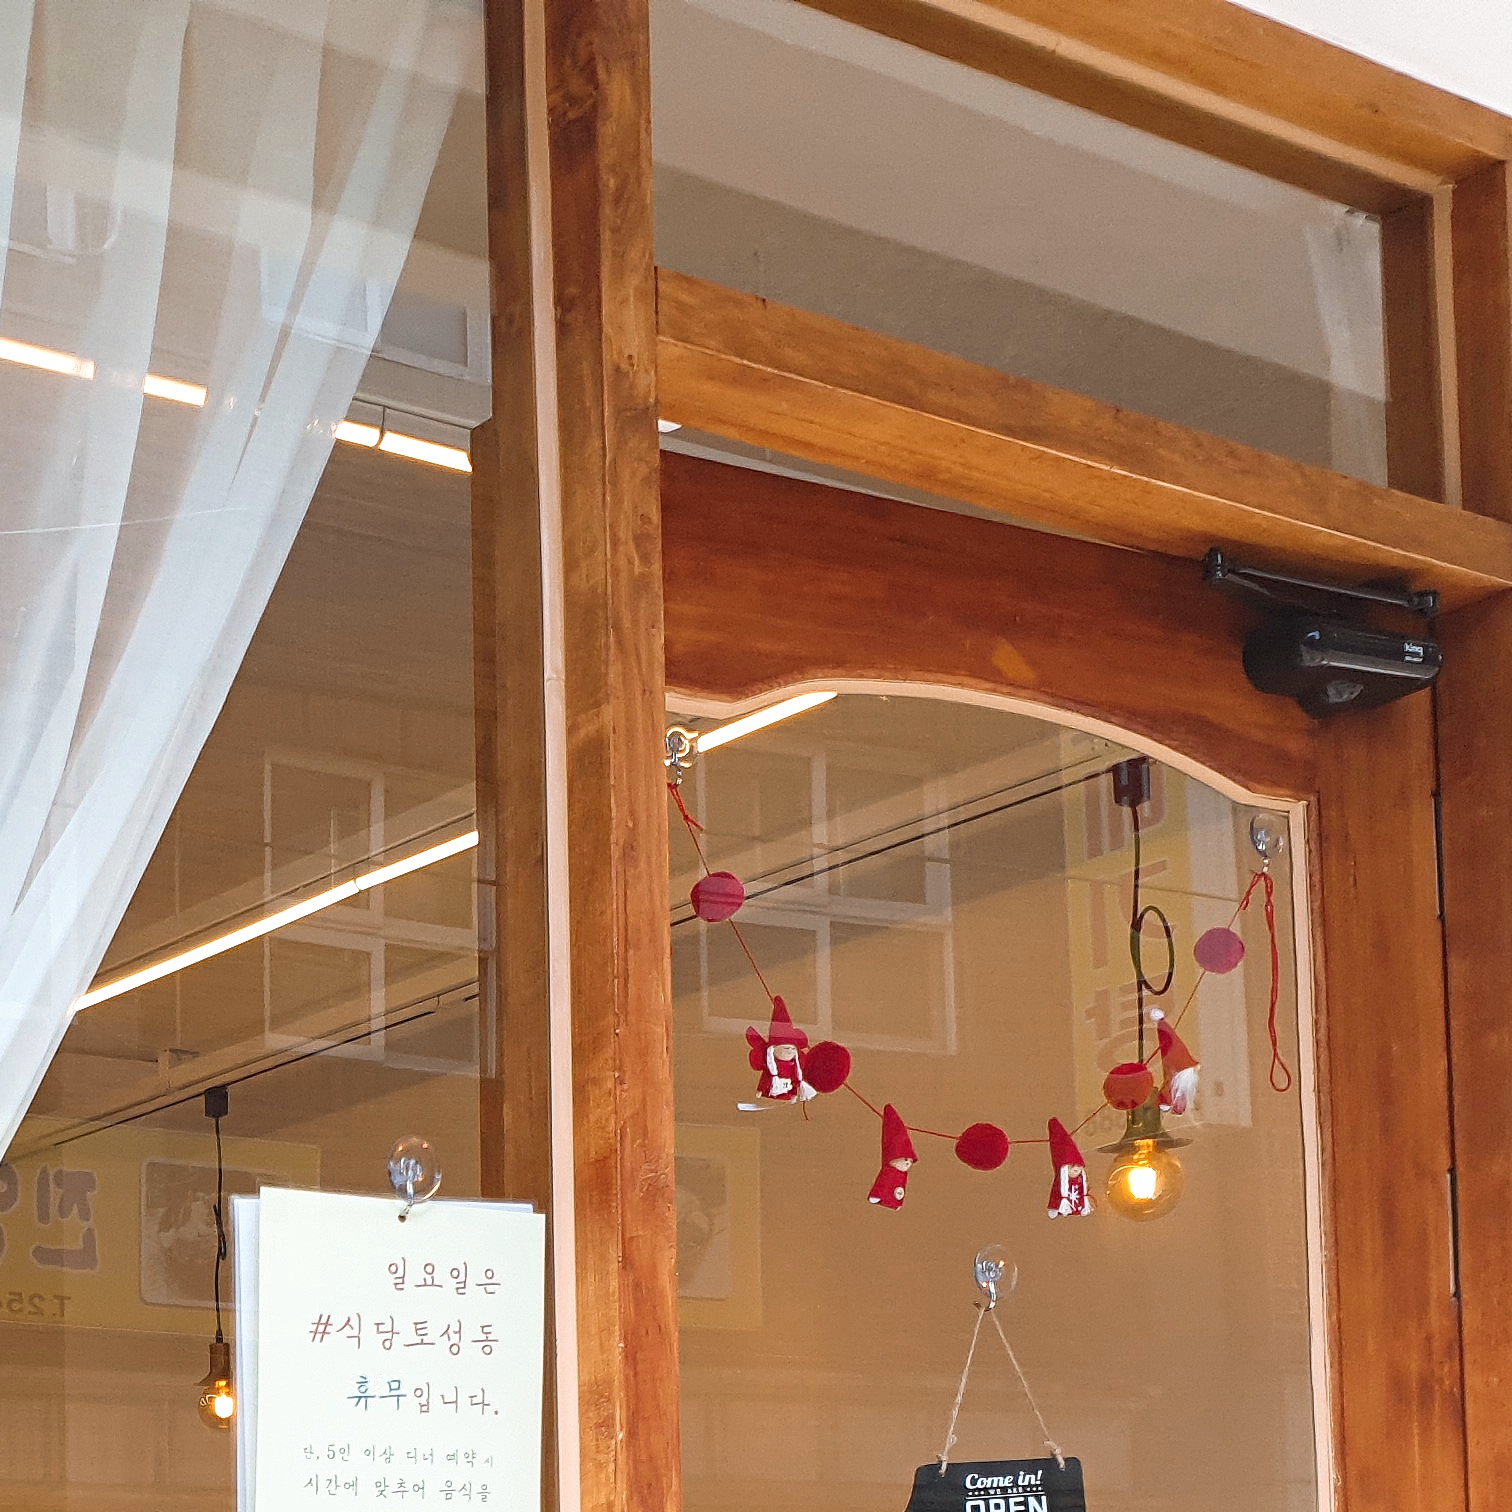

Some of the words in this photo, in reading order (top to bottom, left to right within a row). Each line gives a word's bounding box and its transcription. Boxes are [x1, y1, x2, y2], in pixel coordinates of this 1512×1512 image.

[387, 1256, 502, 1296] 일요일은
[308, 1312, 499, 1357] #식당토성동
[346, 1375, 499, 1416] 휴무입니다.
[363, 1444, 395, 1465] 이상
[303, 1473, 359, 1497] 시간에
[374, 1476, 425, 1500] 맞추어
[439, 1479, 491, 1503] 음식을
[965, 1473, 1014, 1489] Come
[1018, 1469, 1043, 1486] in!
